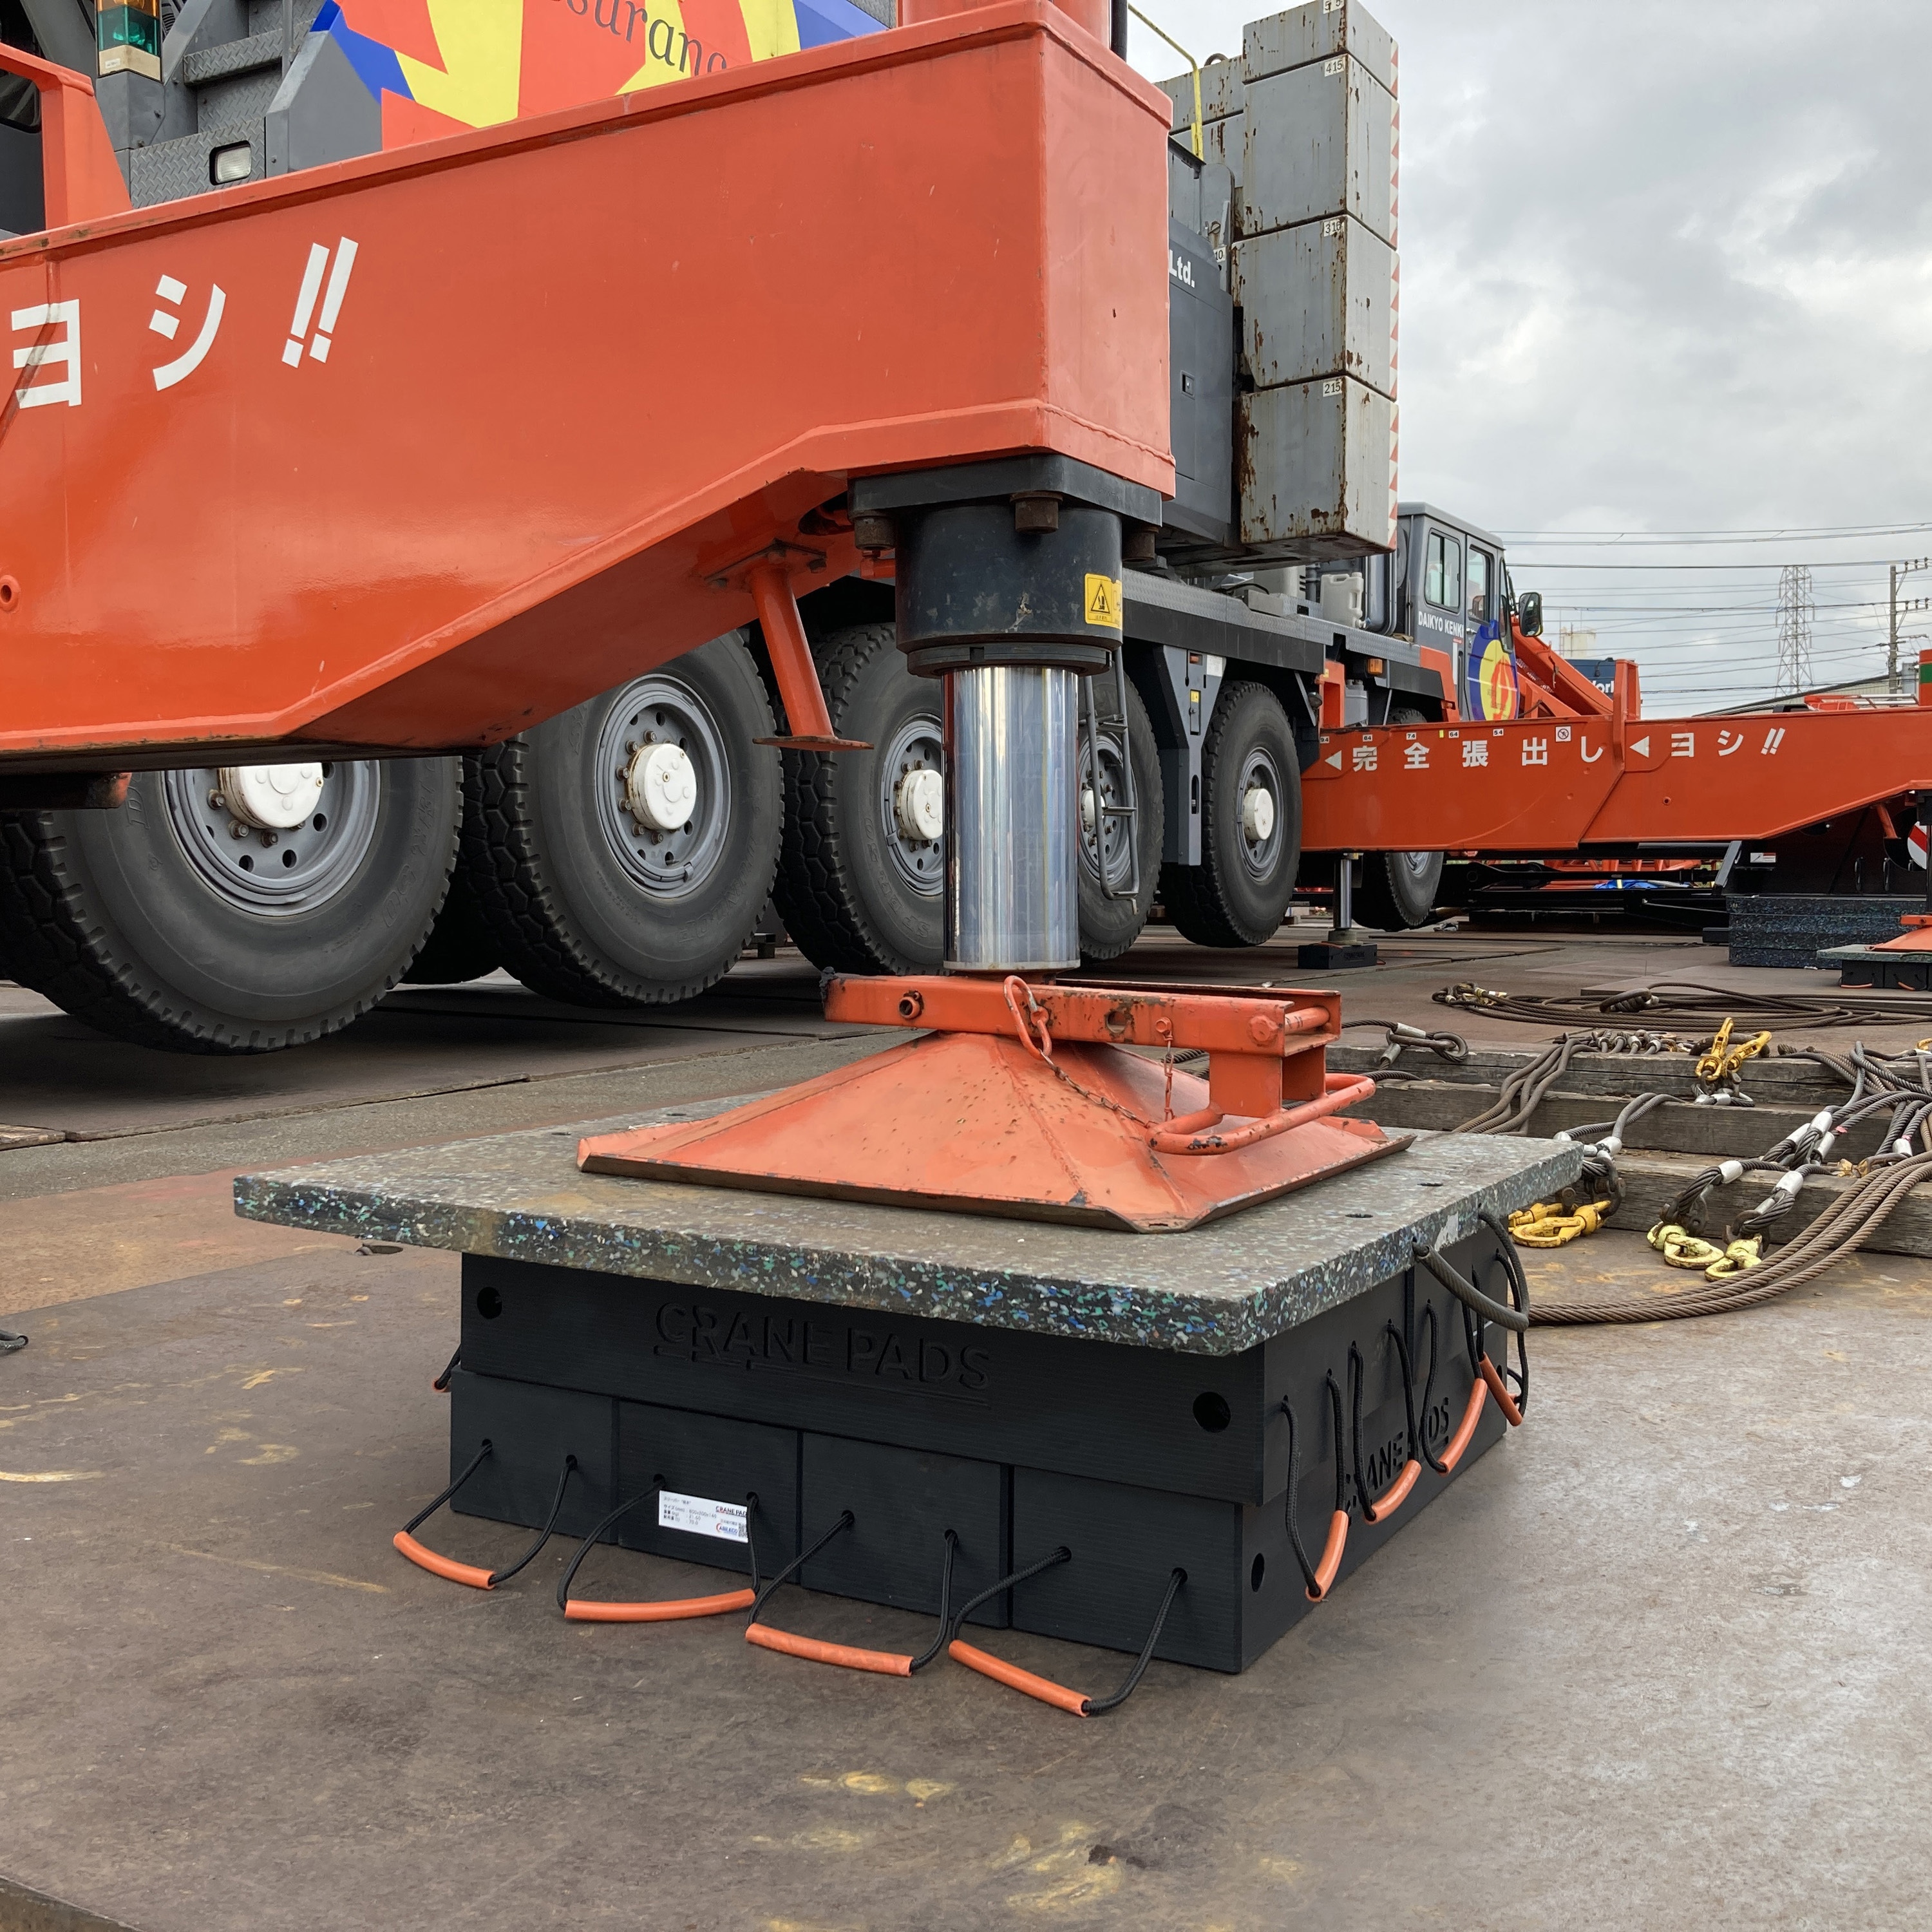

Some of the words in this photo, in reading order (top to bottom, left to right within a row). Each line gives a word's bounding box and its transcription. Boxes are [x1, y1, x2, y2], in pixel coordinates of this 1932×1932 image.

[1326, 60, 1343, 73] 415
[1169, 249, 1195, 289] Ltd.
[1325, 381, 1341, 394] 215
[1418, 611, 1443, 632] DAIKYO
[1444, 619, 1464, 639] KENKI
[1592, 680, 1615, 693] orl
[655, 1302, 834, 1365] CRANE
[846, 1327, 991, 1390] PADS
[715, 1506, 735, 1515] CRANE
